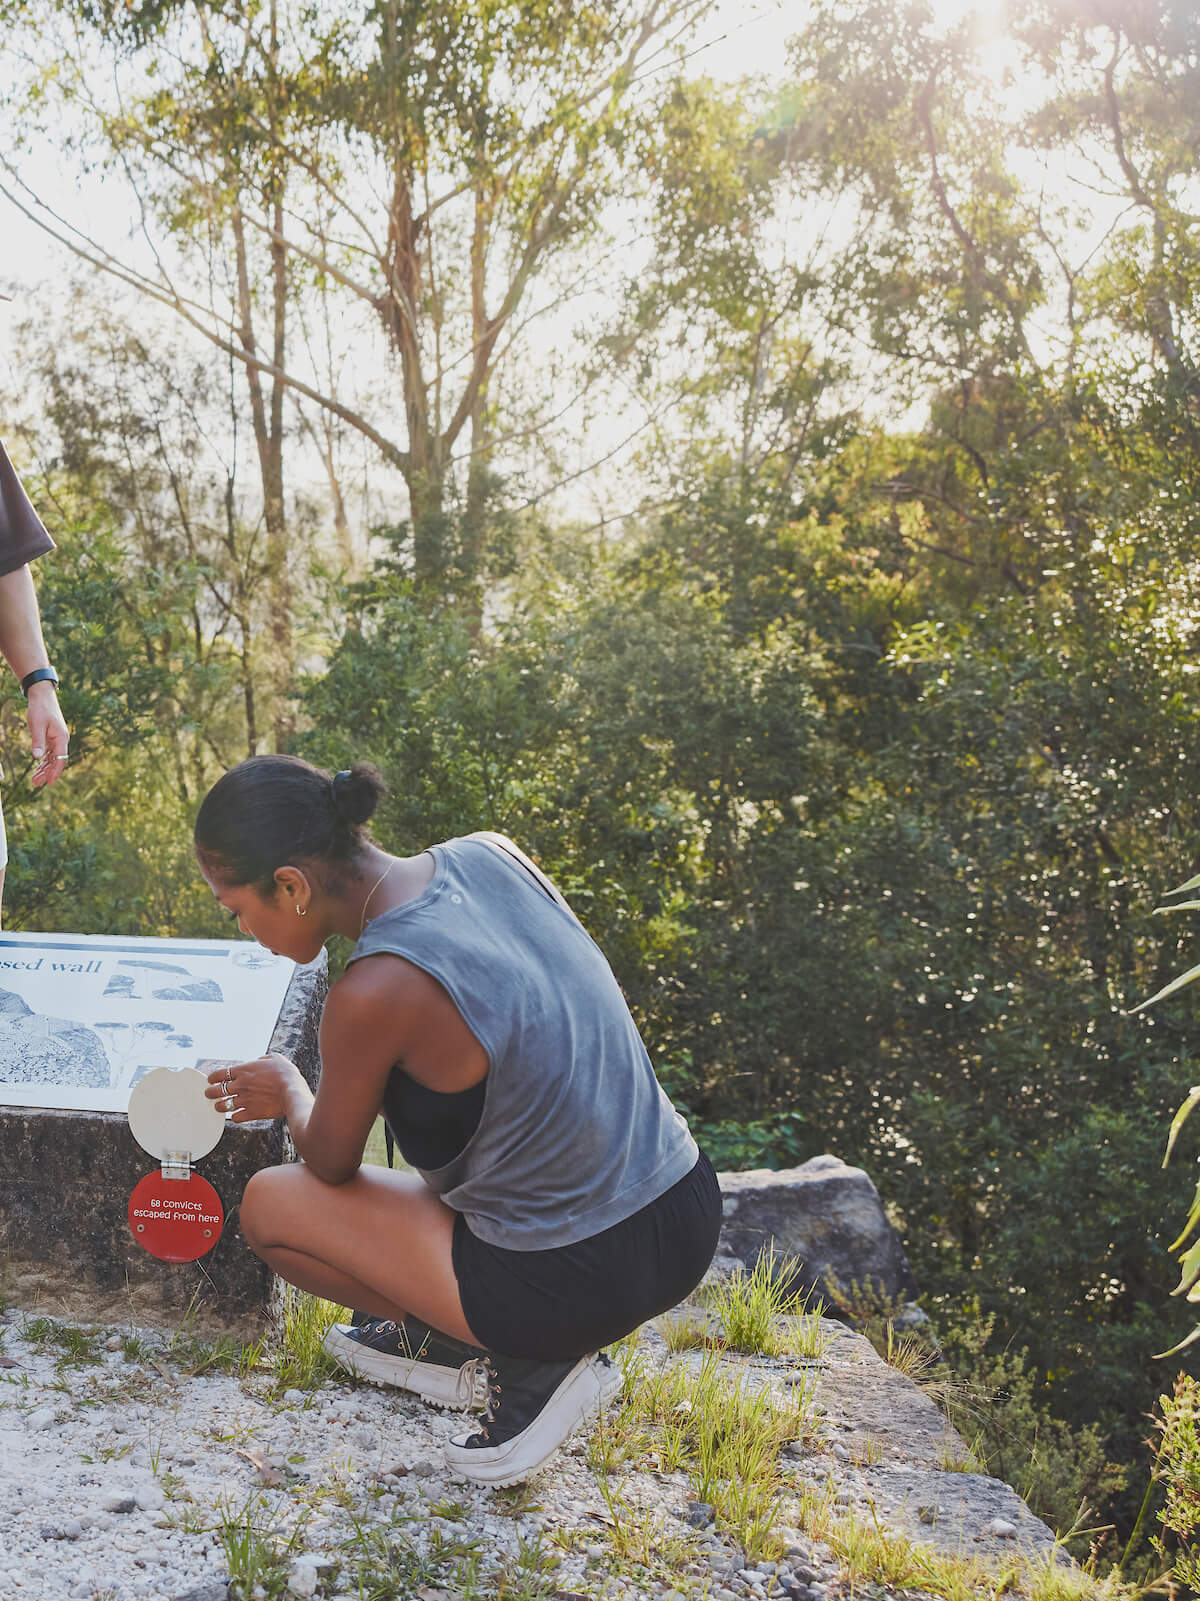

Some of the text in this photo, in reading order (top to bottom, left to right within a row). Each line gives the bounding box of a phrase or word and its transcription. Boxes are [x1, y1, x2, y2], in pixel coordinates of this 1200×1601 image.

[51, 960, 103, 974] wall
[150, 1199, 203, 1211] 68 convicts
[133, 1209, 220, 1223] escaped from here
